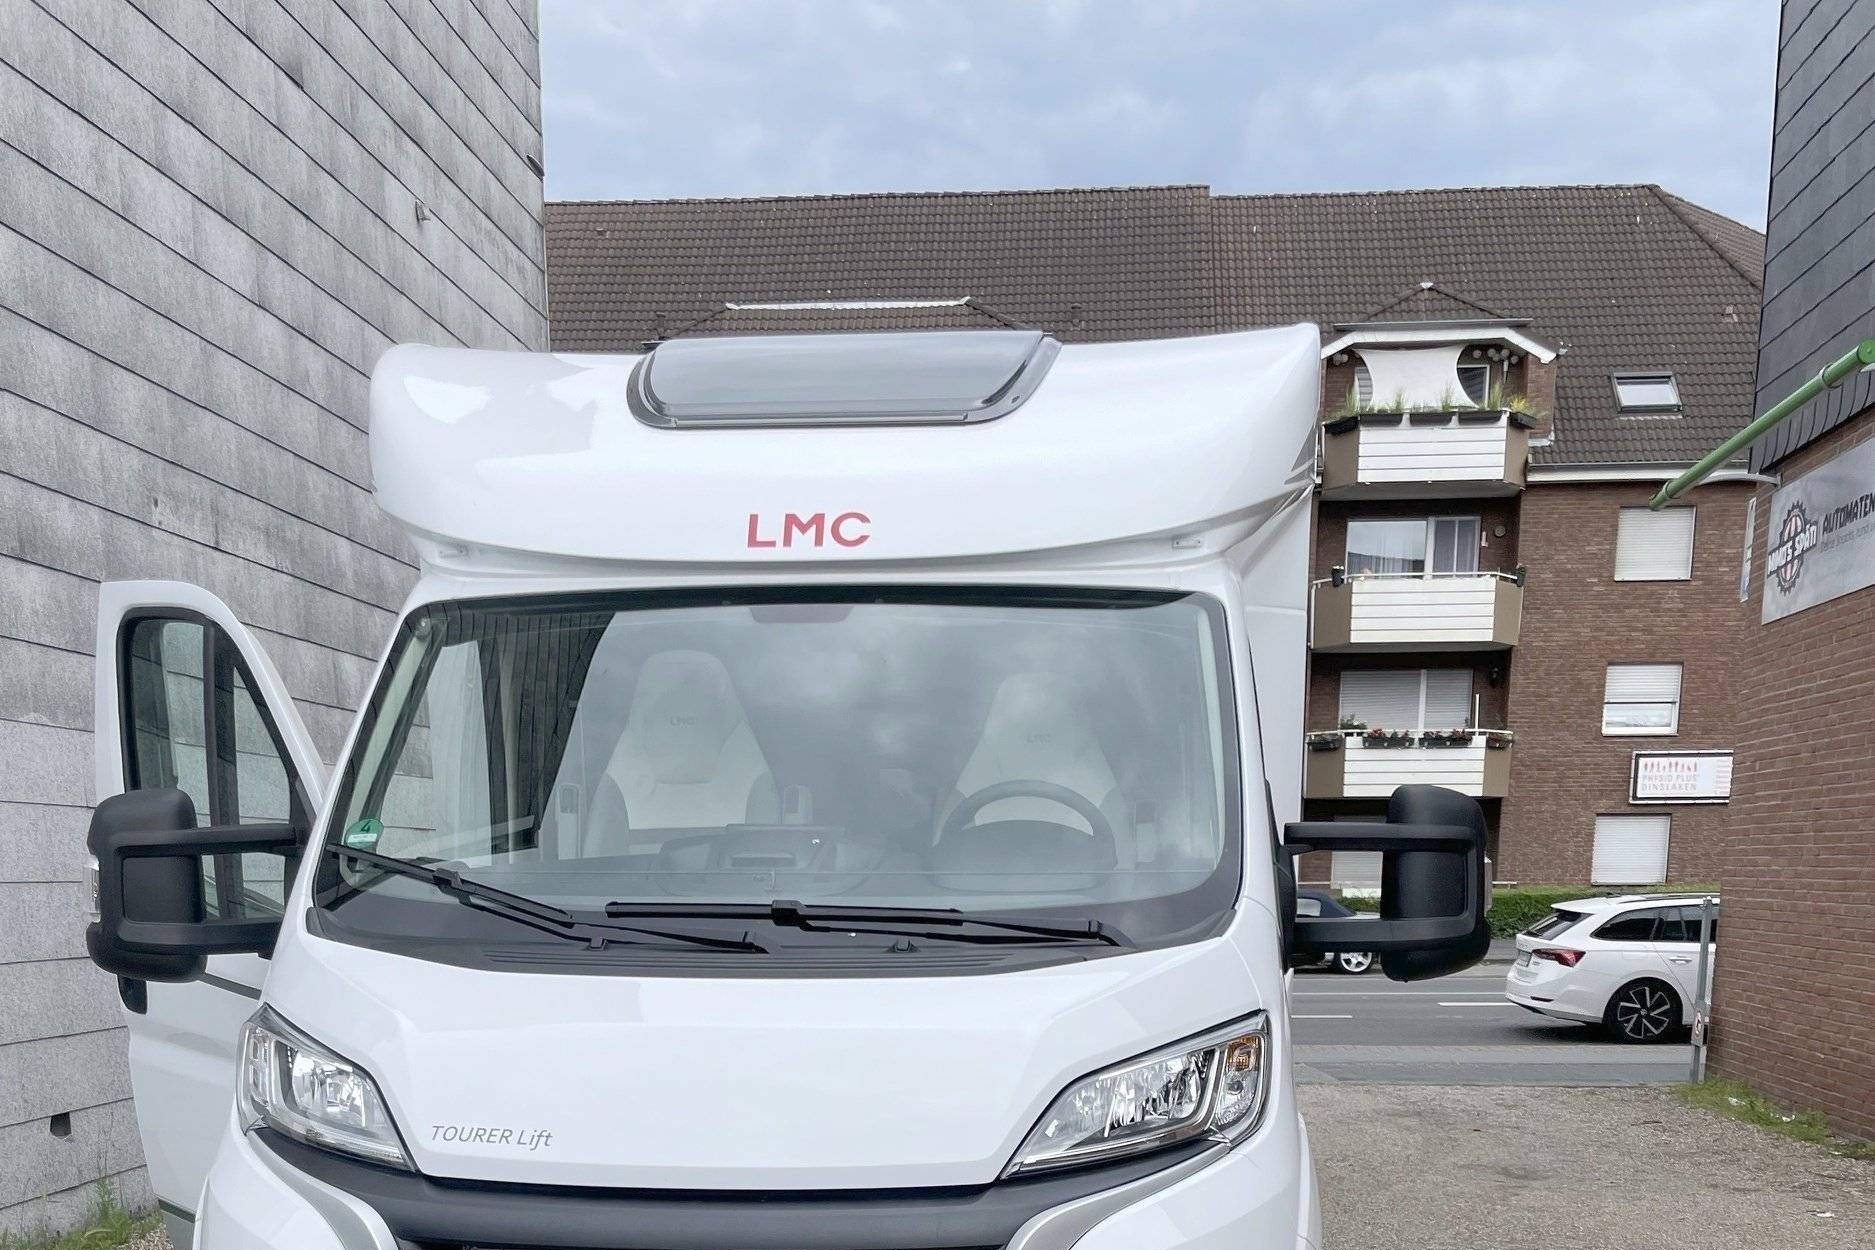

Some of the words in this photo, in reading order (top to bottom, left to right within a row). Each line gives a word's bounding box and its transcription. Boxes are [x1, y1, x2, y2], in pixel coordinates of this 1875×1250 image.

[747, 512, 871, 548] LMC
[360, 820, 370, 833] 4
[431, 1125, 514, 1146] TOURER
[516, 1129, 553, 1151] Lift
